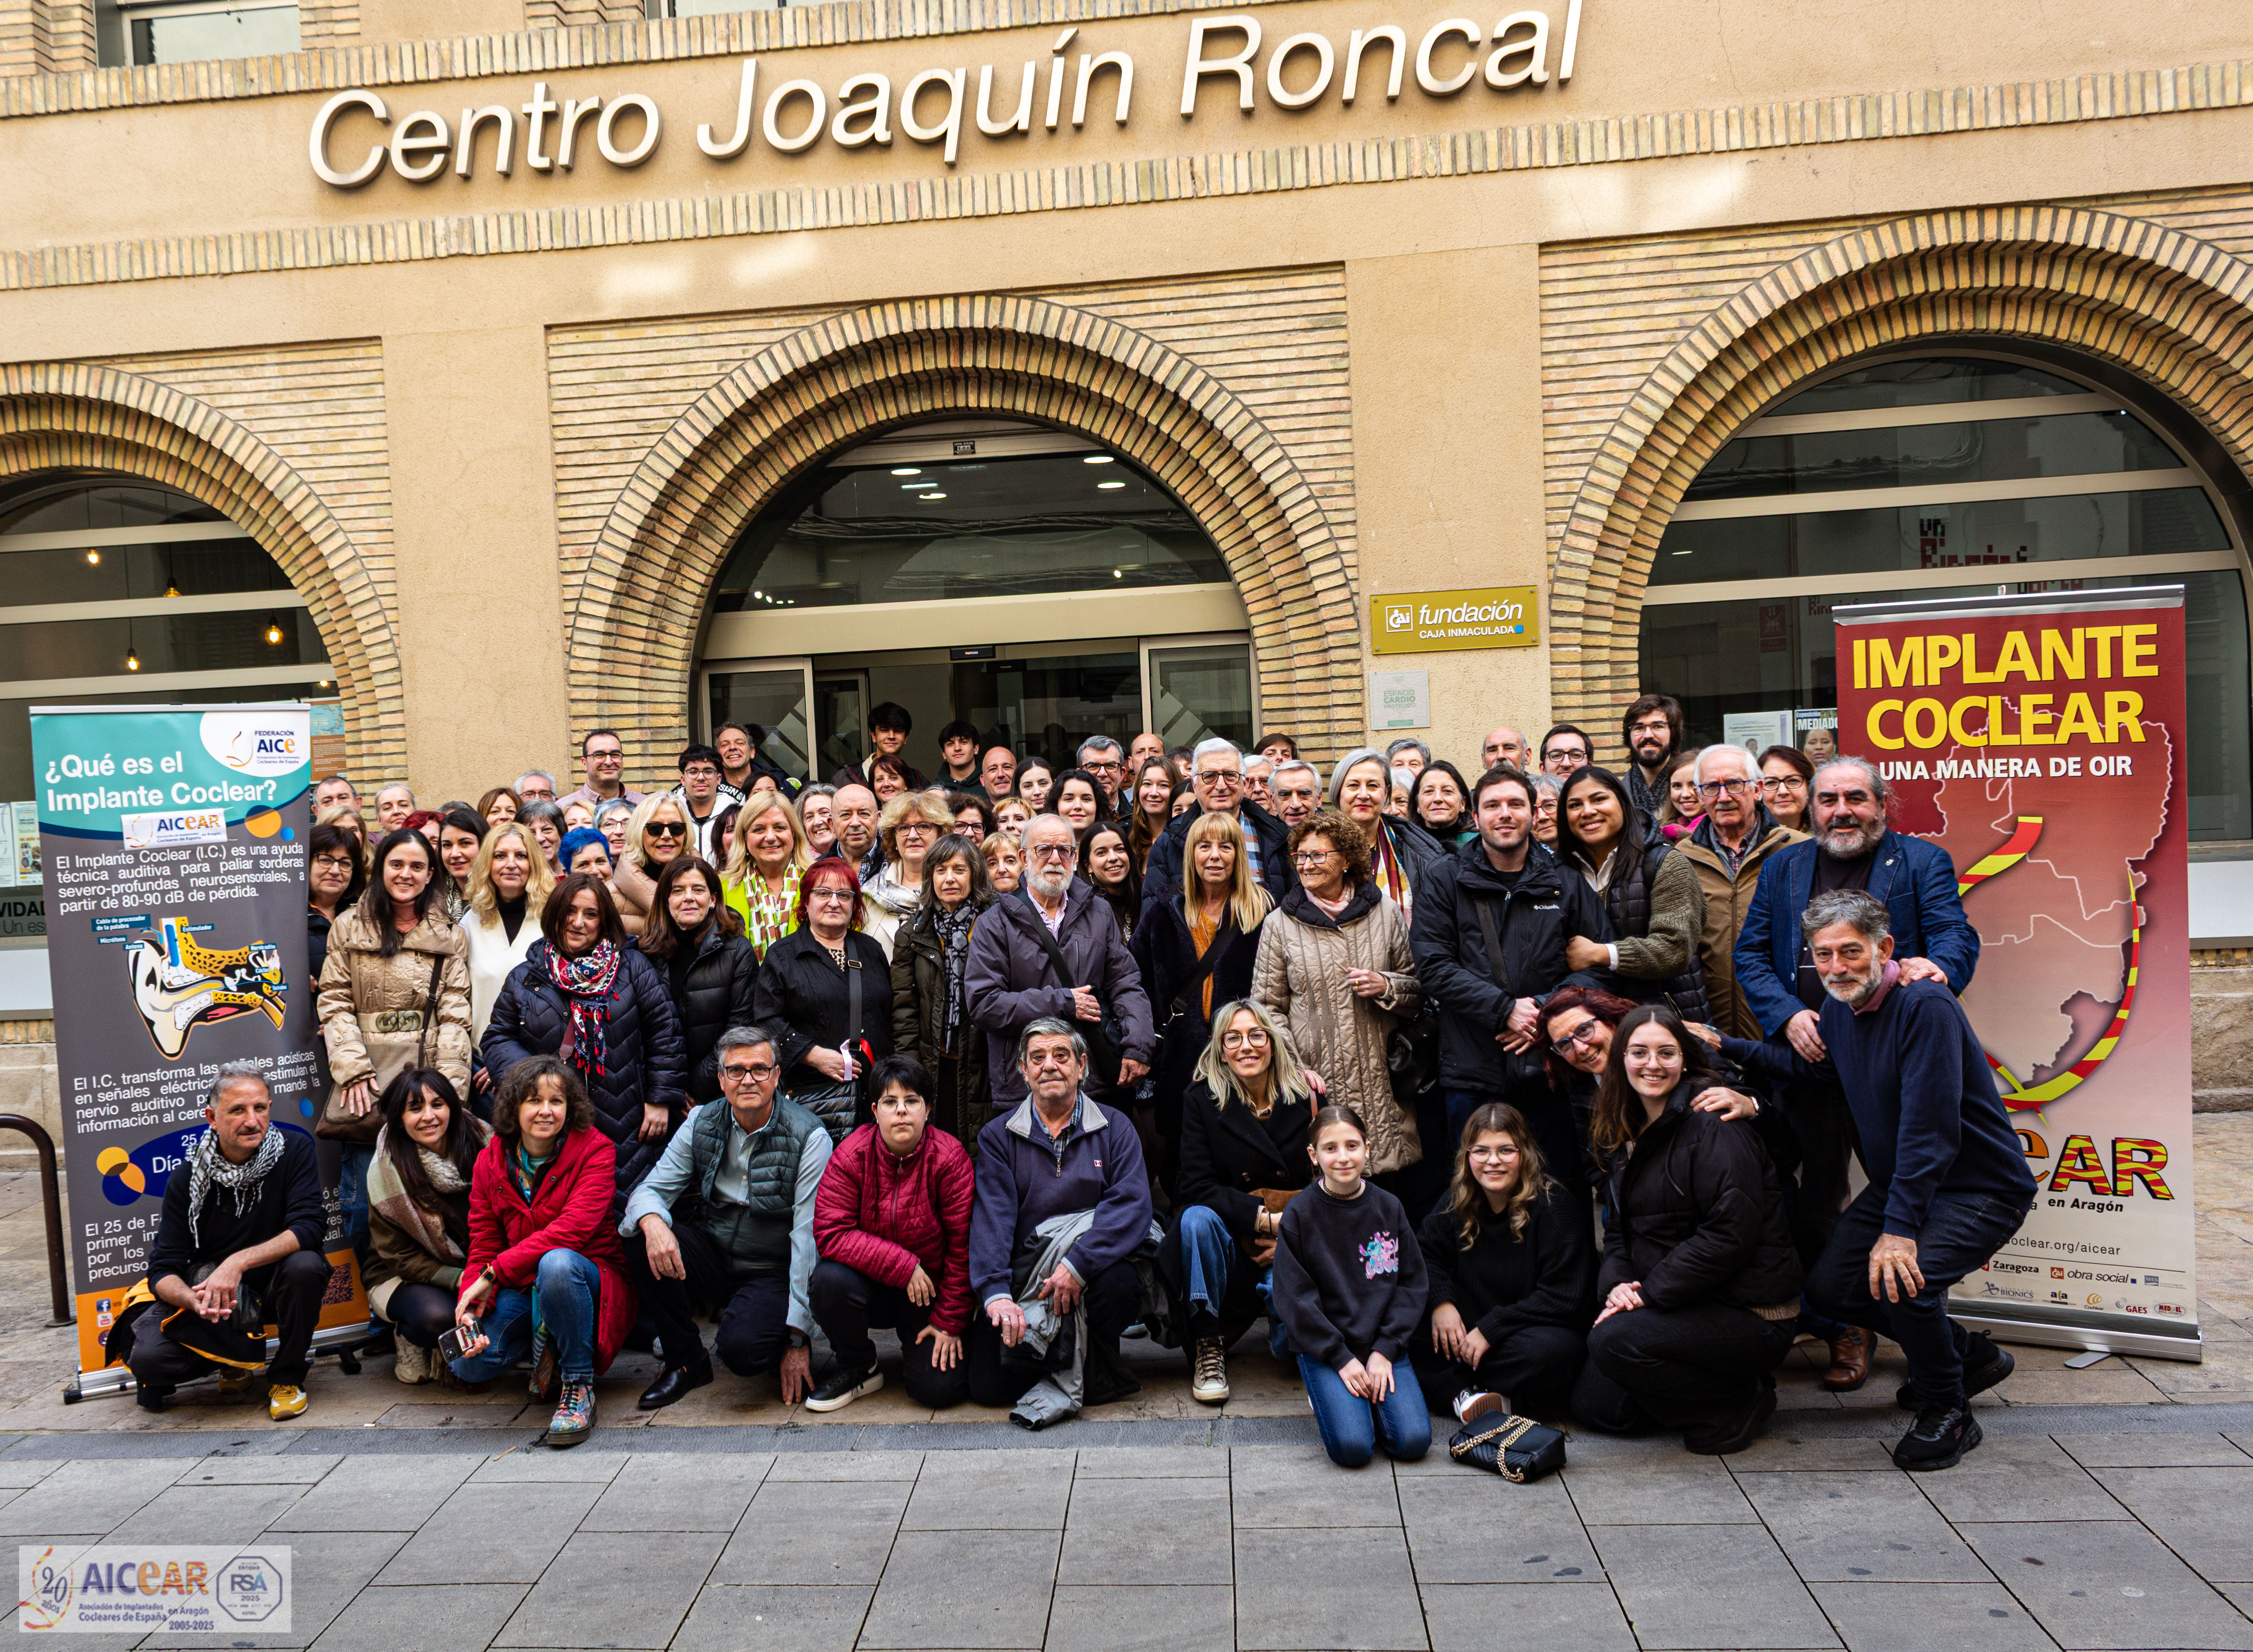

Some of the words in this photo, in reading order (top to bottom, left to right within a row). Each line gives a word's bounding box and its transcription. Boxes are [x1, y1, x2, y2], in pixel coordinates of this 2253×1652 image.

[309, 82, 662, 189] Centro
[697, 28, 1134, 165] Joaquín
[1180, 0, 1582, 118] Roncal
[1419, 599, 1523, 625] fundación
[1419, 630, 1446, 639] CAJA
[1448, 626, 1515, 637] INMACULADA
[1853, 624, 2158, 689] IMPLANTE
[1867, 691, 2146, 750] COCLEAR
[45, 753, 115, 783] ¿Qué
[122, 757, 153, 775] es
[160, 751, 183, 773] el
[1880, 760, 1929, 781] UNA
[1937, 758, 2042, 779] MANERA
[2049, 757, 2081, 778] DE
[2090, 755, 2133, 776] OIR
[47, 786, 163, 815] Implante
[171, 780, 276, 804] Coclear?
[56, 856, 70, 869] El
[75, 853, 134, 869] Implante
[139, 849, 191, 863] Coclear
[196, 845, 227, 861] (I.C.)
[231, 847, 246, 856] es
[250, 846, 267, 856] una
[271, 842, 304, 859] ayuda
[57, 869, 109, 883] técnica
[118, 864, 171, 879] auditiva
[180, 862, 210, 877] para
[219, 858, 253, 873] paliar
[259, 856, 304, 869] sorderas
[58, 878, 179, 898] severo-profundas
[190, 870, 291, 888] neurosensoriales,
[299, 871, 305, 880] a
[60, 898, 97, 915] partir
[100, 896, 119, 909] de
[122, 892, 161, 908] 80-90
[165, 890, 185, 904] dB
[188, 889, 206, 902] de
[209, 885, 259, 903] pérdida.
[118, 915, 146, 924] procesador
[74, 1077, 87, 1090] El
[93, 1074, 116, 1088] I.C.
[121, 1067, 195, 1084] transforma
[200, 1063, 218, 1075] las
[277, 1051, 315, 1065] acústicas
[75, 1094, 92, 1105] en
[98, 1086, 150, 1102] señales
[309, 1062, 317, 1074] el
[76, 1104, 119, 1119] nervio
[131, 1097, 185, 1112] auditivo
[274, 1078, 307, 1094] mande
[311, 1076, 320, 1087] la
[77, 1114, 158, 1133] información
[163, 1110, 174, 1122] al
[181, 1134, 197, 1146] 25
[2048, 1198, 2065, 1207] en
[2070, 1198, 2123, 1213] Aragón
[86, 1223, 98, 1237] El
[104, 1220, 121, 1233] 25
[128, 1217, 145, 1229] de
[323, 1227, 343, 1241] ual.
[87, 1235, 132, 1254] primer
[88, 1252, 112, 1268] por
[124, 1247, 144, 1259] los
[1993, 1261, 2039, 1274] Zaragoza
[2068, 1269, 2092, 1280] obra
[2096, 1273, 2129, 1283] social
[2001, 1289, 2034, 1299] BIONICS
[2126, 1305, 2147, 1314] GAES
